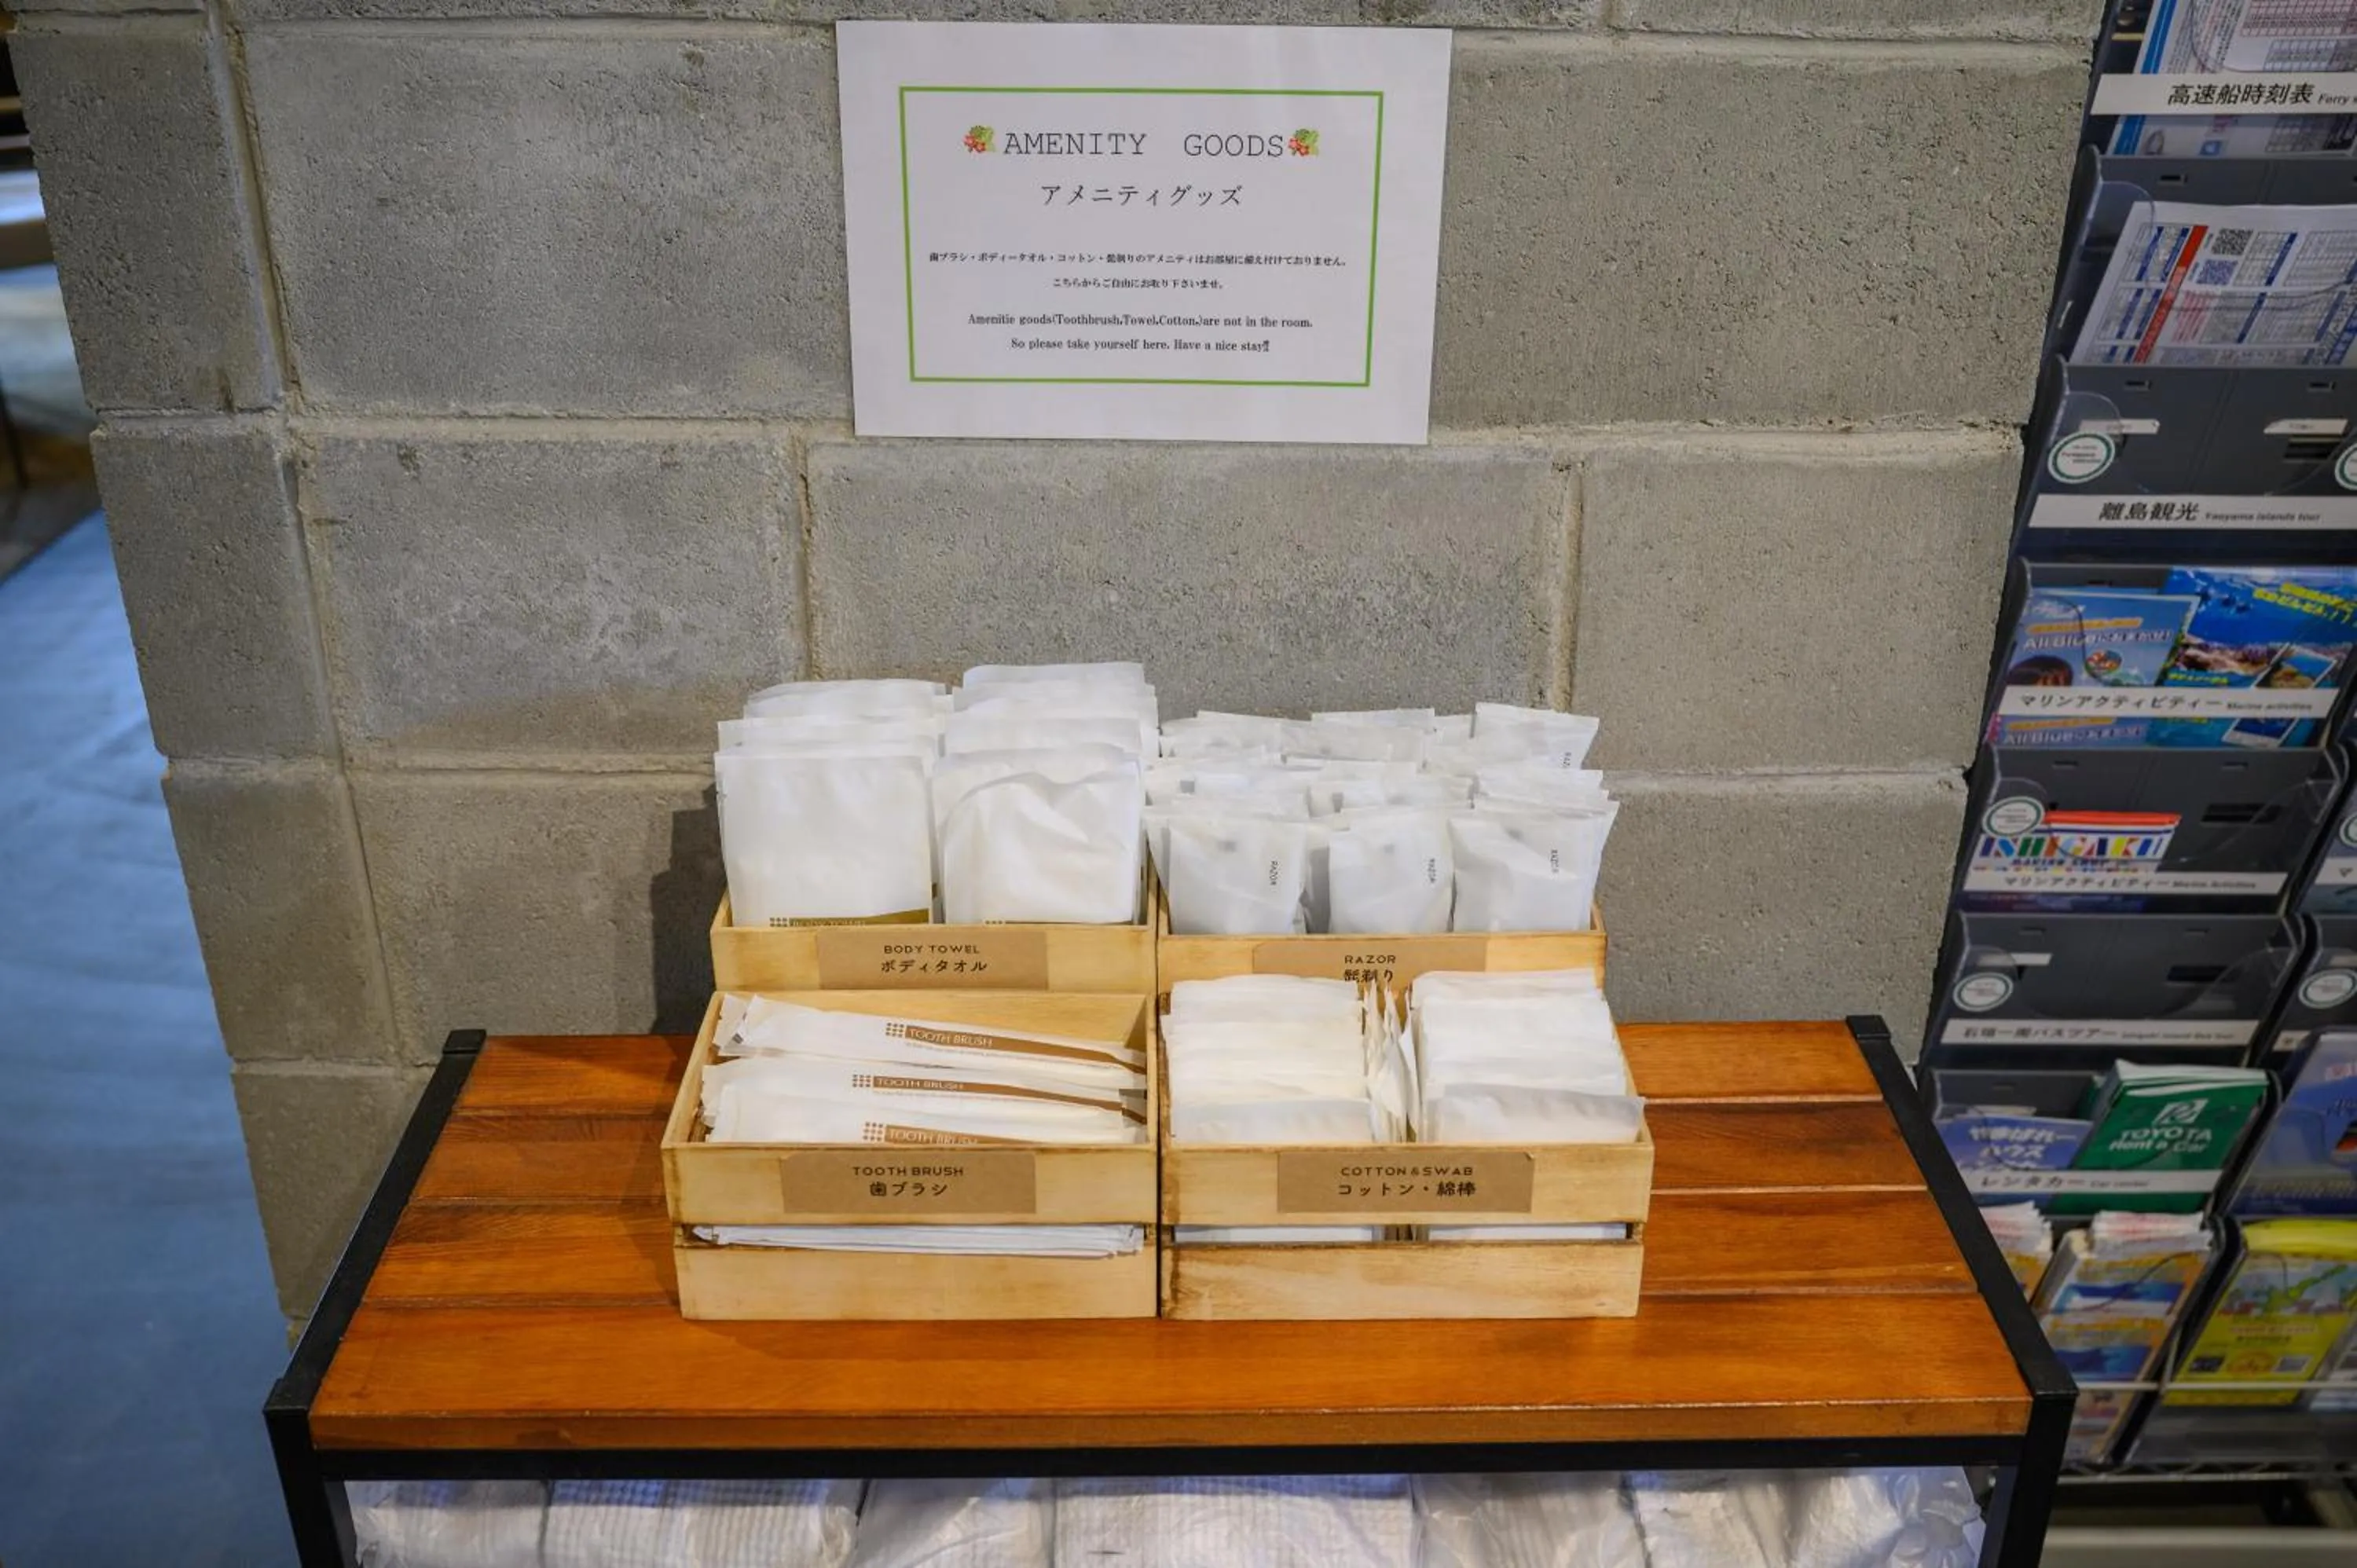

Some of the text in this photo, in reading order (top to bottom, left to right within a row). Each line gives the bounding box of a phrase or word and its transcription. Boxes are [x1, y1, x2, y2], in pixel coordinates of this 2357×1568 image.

[2167, 82, 2315, 105] 高速船時刻表
[2317, 93, 2350, 106] Ferry
[1003, 132, 1284, 157] AMENITY GOODS
[1040, 184, 1244, 207] アメニティグッズ
[1223, 317, 1242, 328] not
[1245, 315, 1257, 328] in
[1260, 316, 1278, 328] the
[1281, 318, 1314, 328] room.
[1010, 337, 1025, 349] So
[1028, 337, 1063, 350] please
[1066, 337, 1091, 350] take
[1094, 337, 1138, 350] yourself
[1142, 339, 1170, 350] here.
[1173, 339, 1201, 351] Have
[1204, 342, 1211, 351] a
[1215, 339, 1237, 352] nice
[2098, 501, 2201, 522] 離島観光
[2020, 693, 2223, 709] マリンアクティビティー
[884, 944, 981, 954] BODY TOWEL
[880, 958, 988, 973] ボディタオル
[1343, 954, 1396, 965] RAZOR
[909, 1028, 994, 1048] TOOTH BRUSH
[876, 1077, 965, 1091] TOOTH BRUSH
[2120, 1126, 2213, 1141] TOYOTA
[2108, 1138, 2209, 1154] Rent a Car
[852, 1166, 964, 1177] TOOTH BRUSH
[1340, 1167, 1407, 1177] COTTON
[869, 1181, 948, 1197] 歯ブラシ
[1338, 1181, 1477, 1197] コットン・綿棒
[1981, 1175, 2086, 1189] レンタカー
